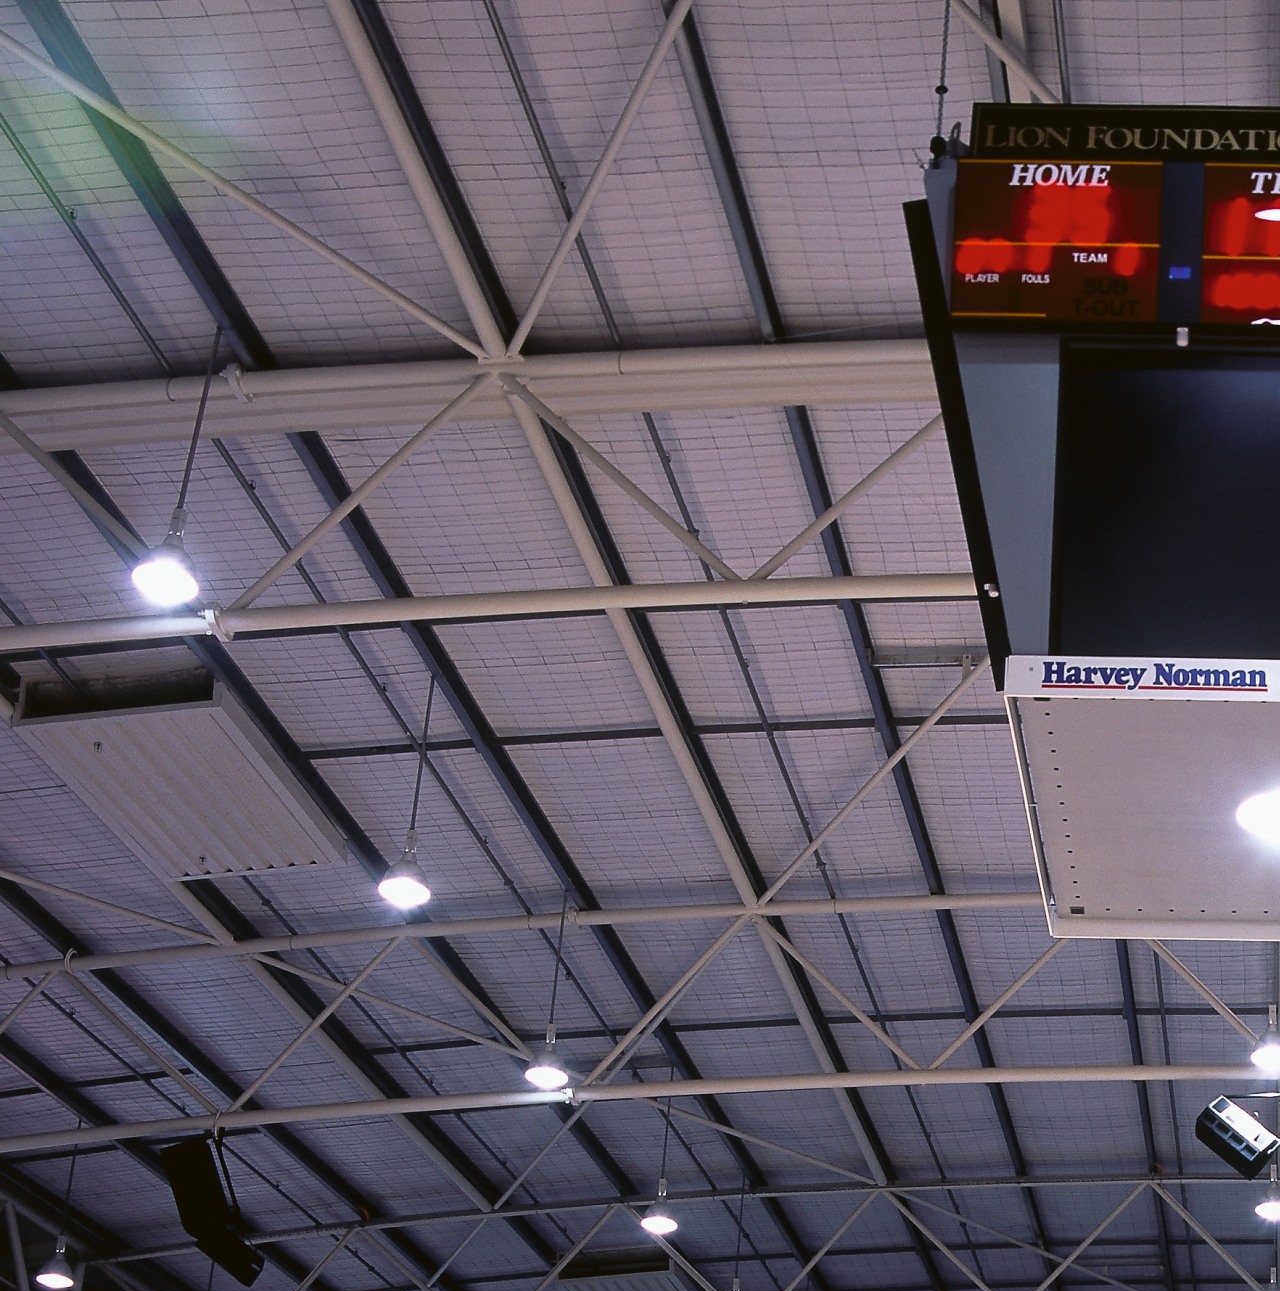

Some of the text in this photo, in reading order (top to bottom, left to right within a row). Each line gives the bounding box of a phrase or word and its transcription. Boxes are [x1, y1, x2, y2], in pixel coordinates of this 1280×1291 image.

[984, 124, 1072, 148] LION
[1009, 164, 1111, 187] HOME
[1072, 253, 1108, 263] TEAM
[965, 273, 999, 284] PLAYER
[1021, 274, 1050, 284] FOULS
[1042, 661, 1268, 690] Harvey Norman
